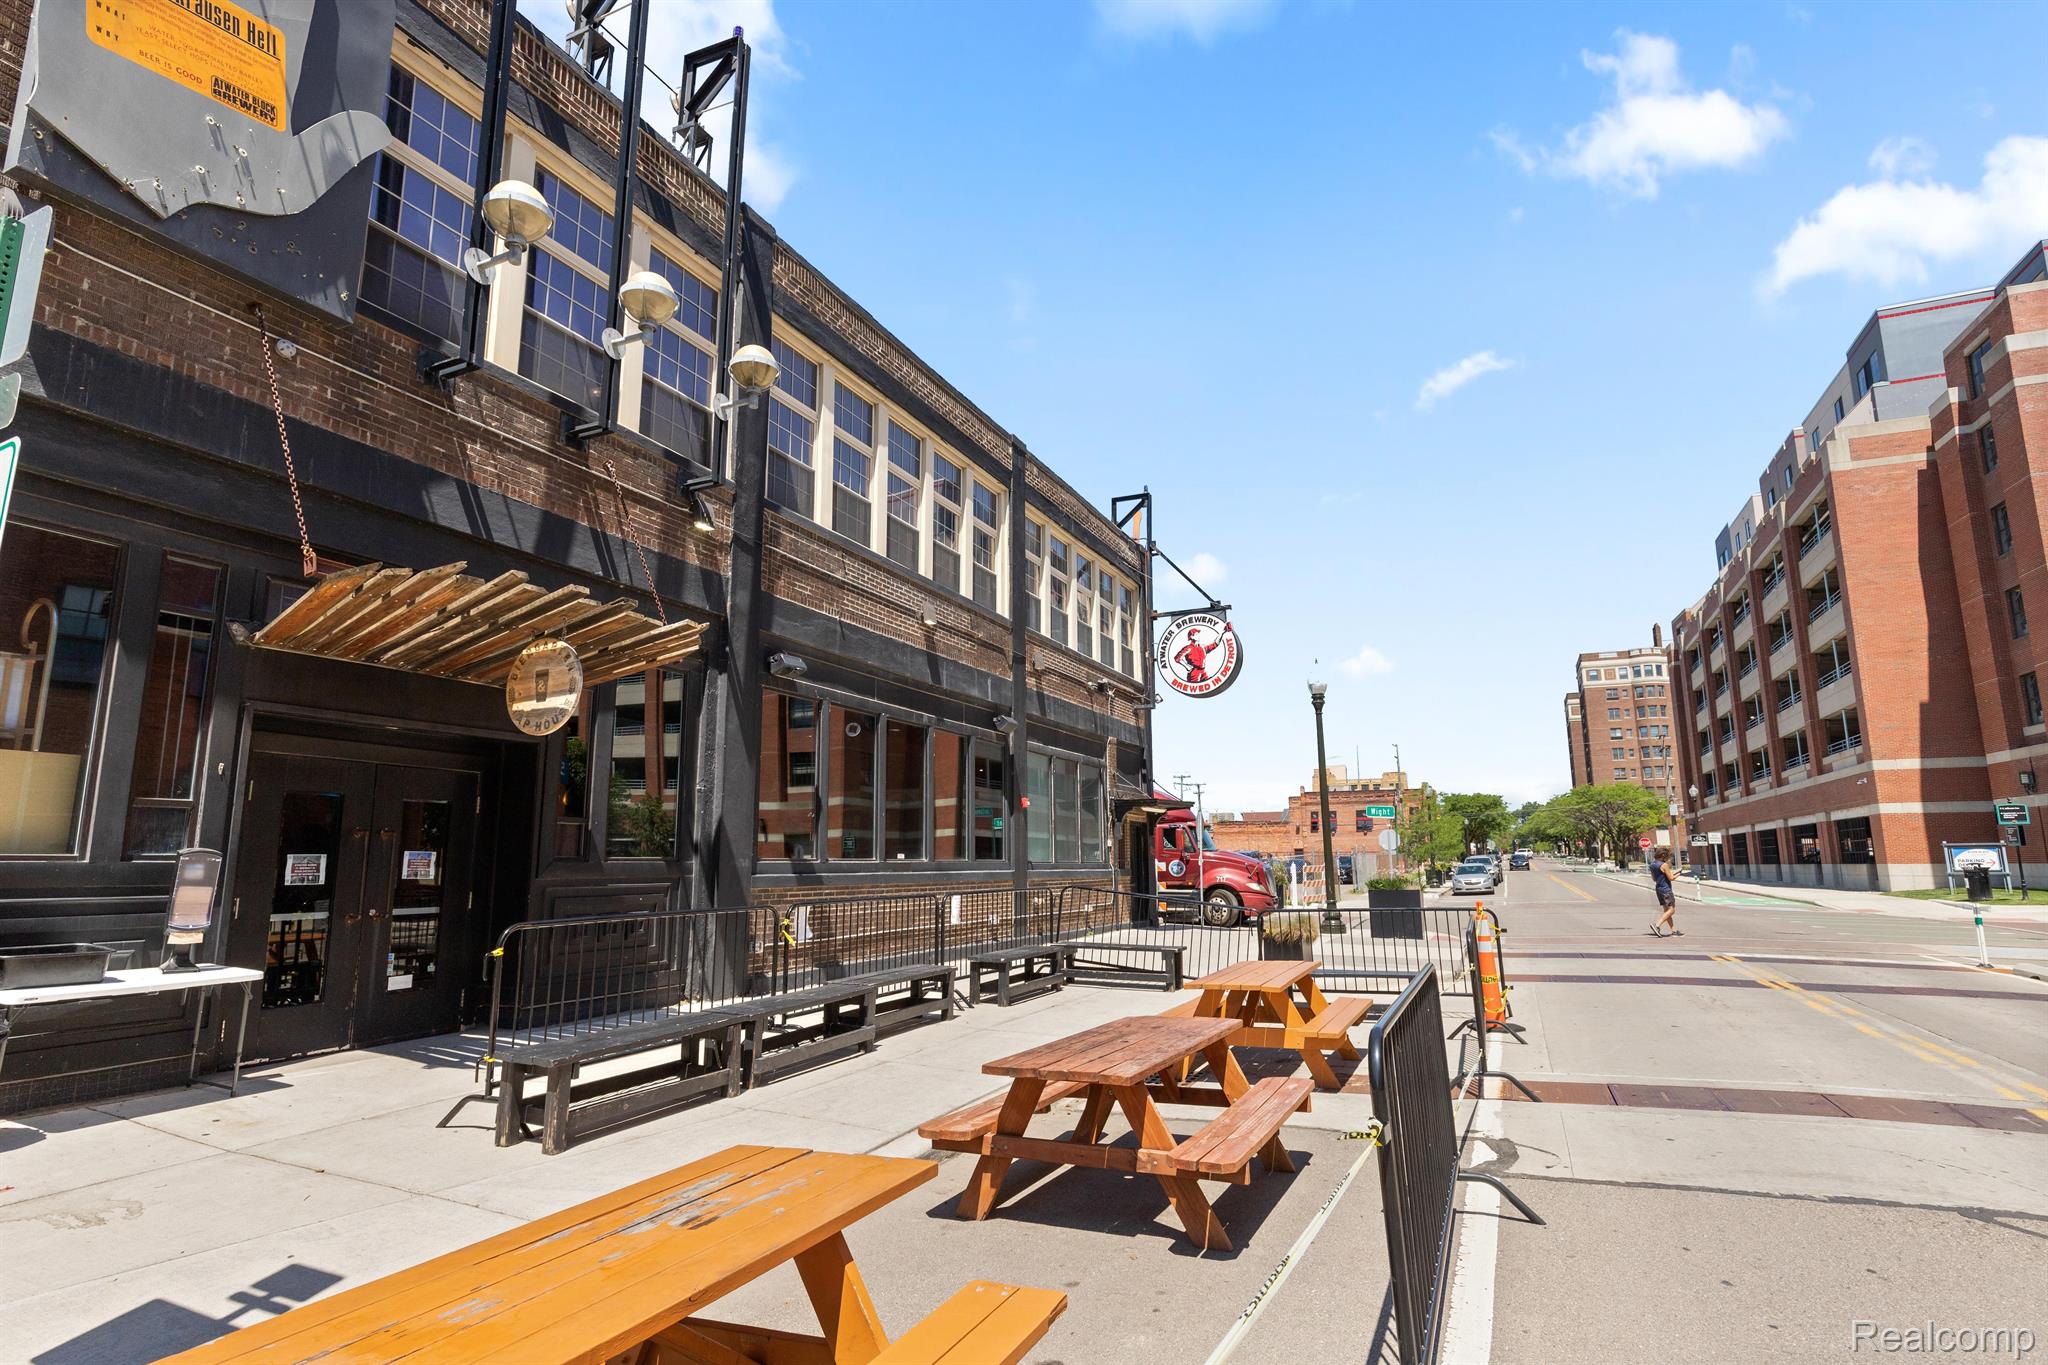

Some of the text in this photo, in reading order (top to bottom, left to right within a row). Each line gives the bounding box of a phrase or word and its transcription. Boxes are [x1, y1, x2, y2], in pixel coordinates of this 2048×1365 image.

[248, 20, 277, 56] Hell
[139, 49, 161, 65] BEER
[164, 59, 172, 70] IS
[175, 66, 203, 85] GOOD
[213, 77, 250, 101] ATWATER
[252, 96, 276, 117] BLOCK
[213, 88, 276, 123] BREWERY
[1160, 615, 1219, 669] ATWATER BREWERY
[1171, 637, 1234, 693] BREWED IN DETROIT
[537, 680, 546, 692] &
[1371, 808, 1390, 816] Wight
